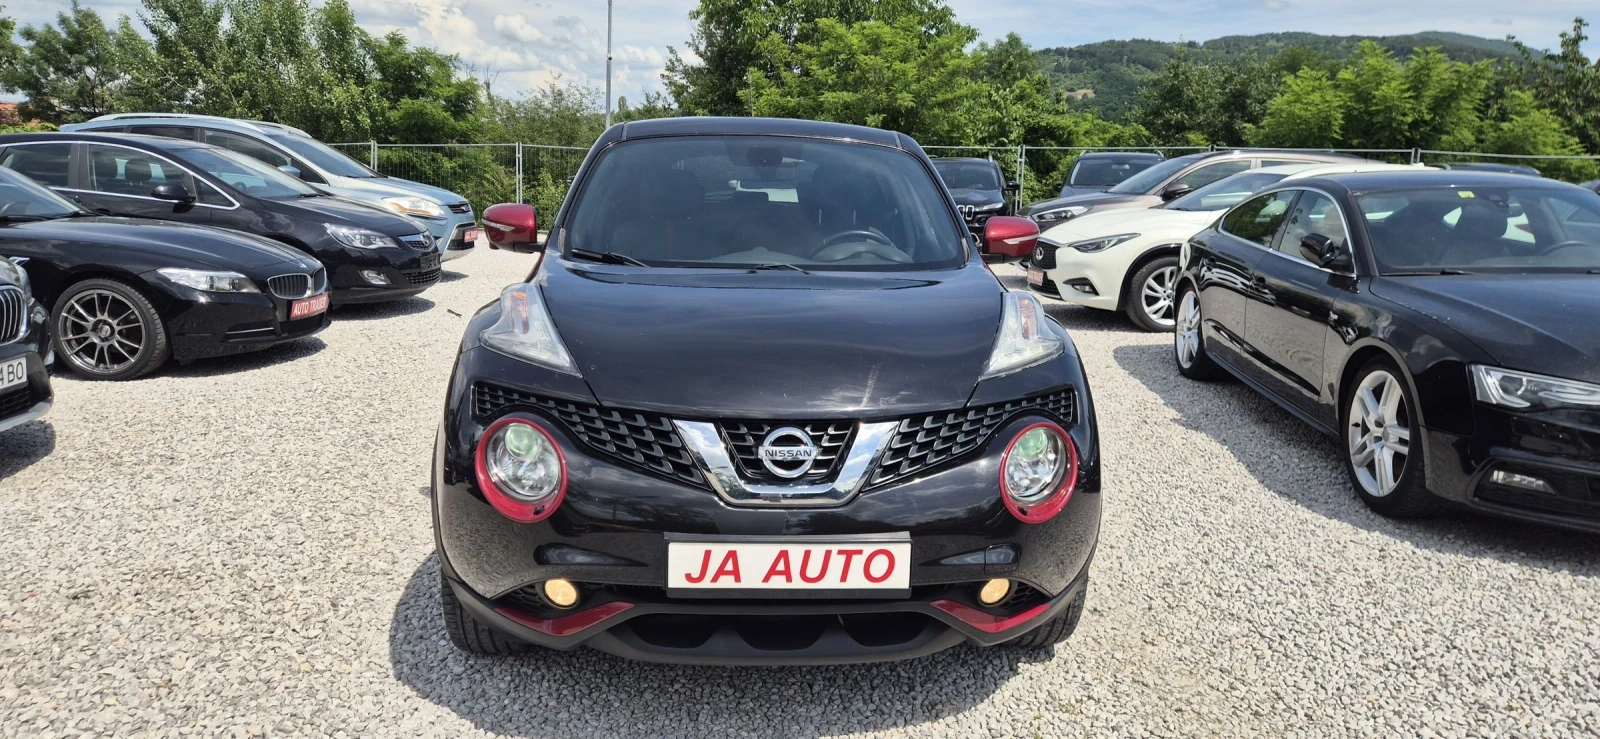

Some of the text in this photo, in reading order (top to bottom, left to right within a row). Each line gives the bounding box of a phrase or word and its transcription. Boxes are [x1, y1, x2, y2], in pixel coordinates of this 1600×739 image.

[293, 302, 309, 316] AUTO
[765, 449, 812, 457] NISSAN
[684, 548, 896, 584] JA AUTO
